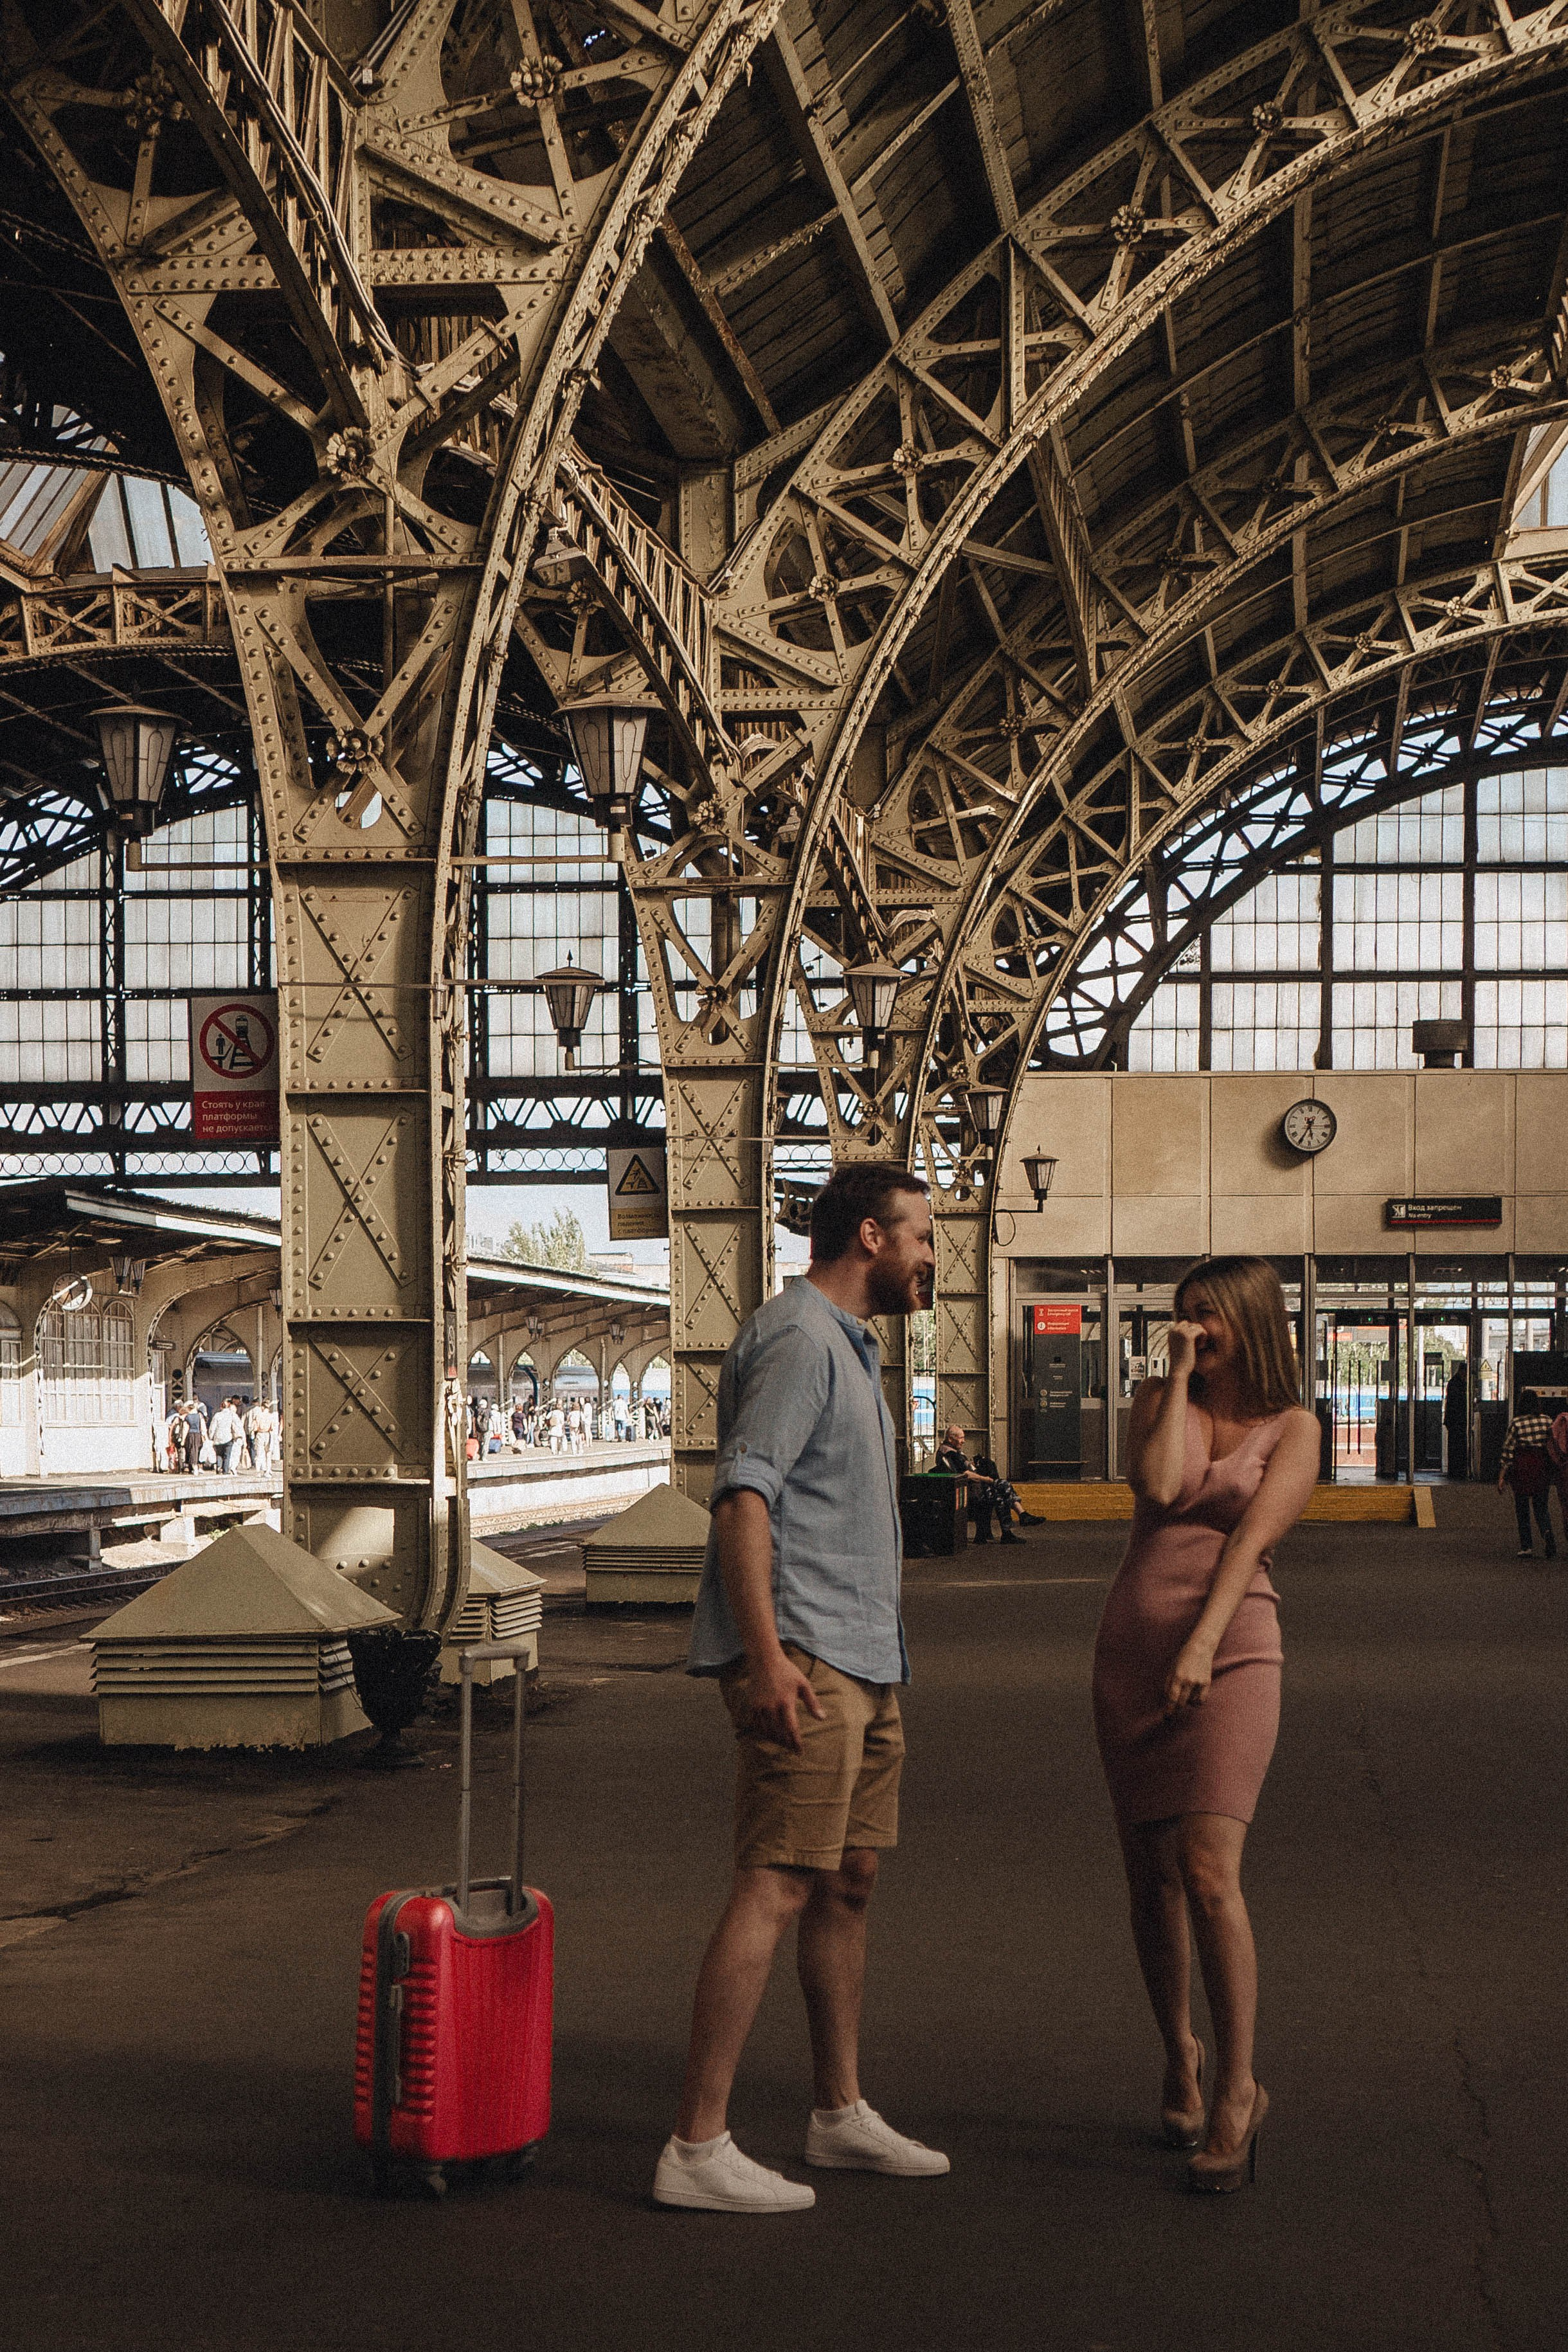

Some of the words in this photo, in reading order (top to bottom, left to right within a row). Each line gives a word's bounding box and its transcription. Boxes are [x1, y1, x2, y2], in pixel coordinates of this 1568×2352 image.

[202, 1100, 233, 1109] Стоять
[235, 1101, 240, 1110] у
[203, 1112, 258, 1122] платформы
